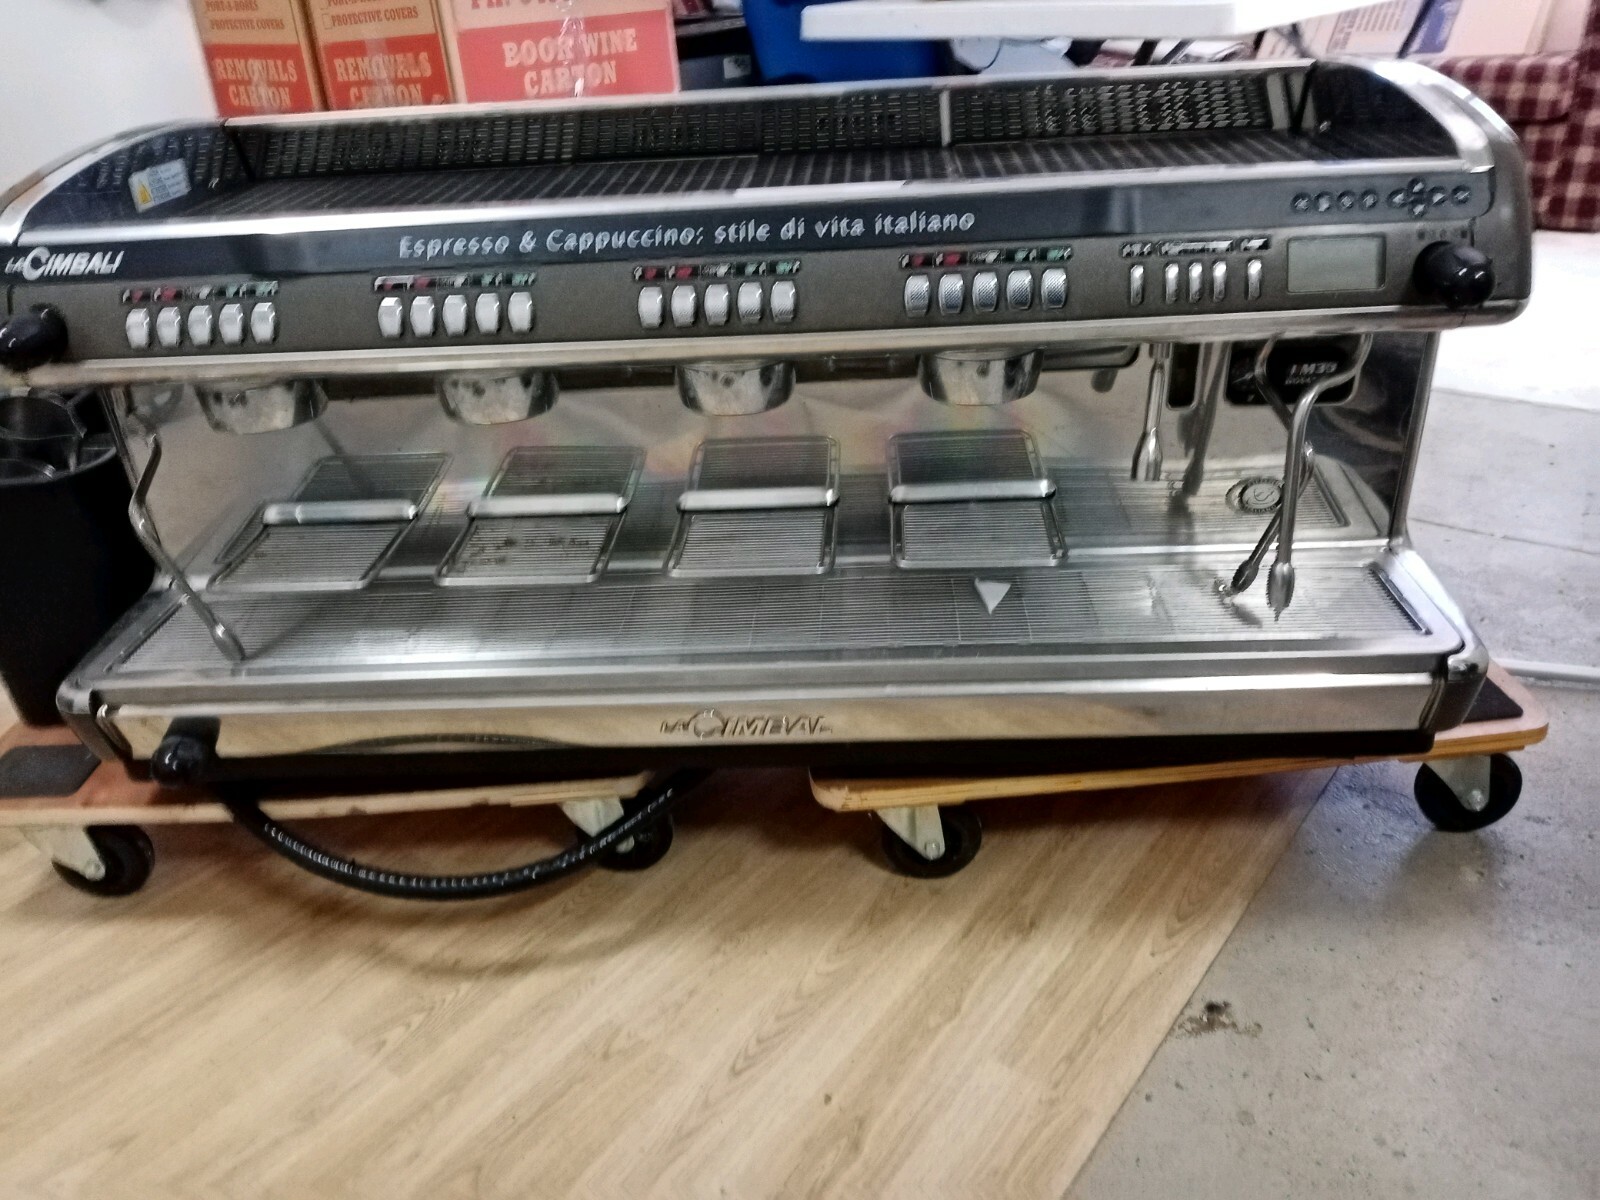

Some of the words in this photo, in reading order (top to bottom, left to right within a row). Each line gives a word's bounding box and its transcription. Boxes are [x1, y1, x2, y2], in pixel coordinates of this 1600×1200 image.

[210, 19, 255, 30] PROTECTIVE
[331, 10, 382, 27] PROTECTIVE
[384, 6, 419, 21] COVERS
[502, 36, 574, 67] BOOK
[579, 28, 638, 57] WINE
[213, 58, 298, 82] REMOVALS
[333, 52, 432, 82] REMOVALS
[523, 60, 618, 97] CARTON
[228, 85, 291, 109] CARTON
[399, 235, 511, 261] Espresso
[518, 230, 537, 253] &
[714, 218, 770, 244] stile
[780, 216, 805, 239] di
[815, 215, 866, 238] vita
[875, 210, 976, 235] italiano
